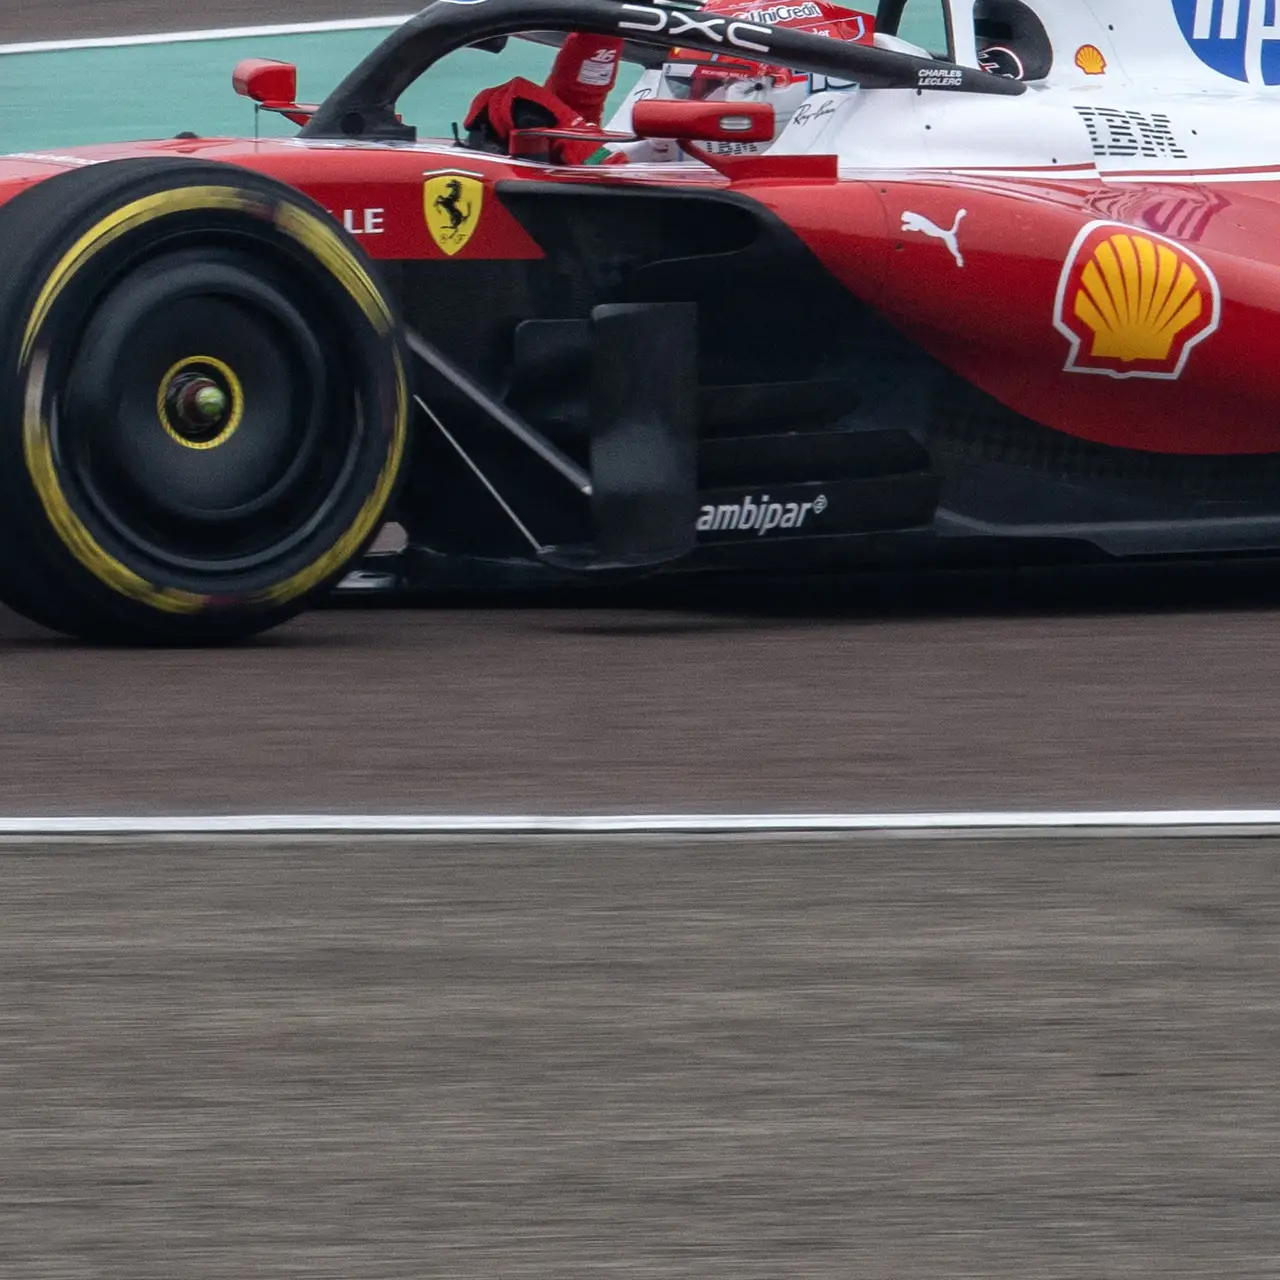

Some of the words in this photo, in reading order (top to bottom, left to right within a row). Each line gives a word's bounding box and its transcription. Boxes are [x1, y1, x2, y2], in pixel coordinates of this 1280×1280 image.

[618, 3, 773, 53] DXC
[747, 2, 823, 25] UniCredit
[917, 69, 963, 78] CHARLES
[917, 77, 963, 86] LECLERC
[1073, 105, 1188, 159] IBM
[695, 494, 813, 535] ambipar
